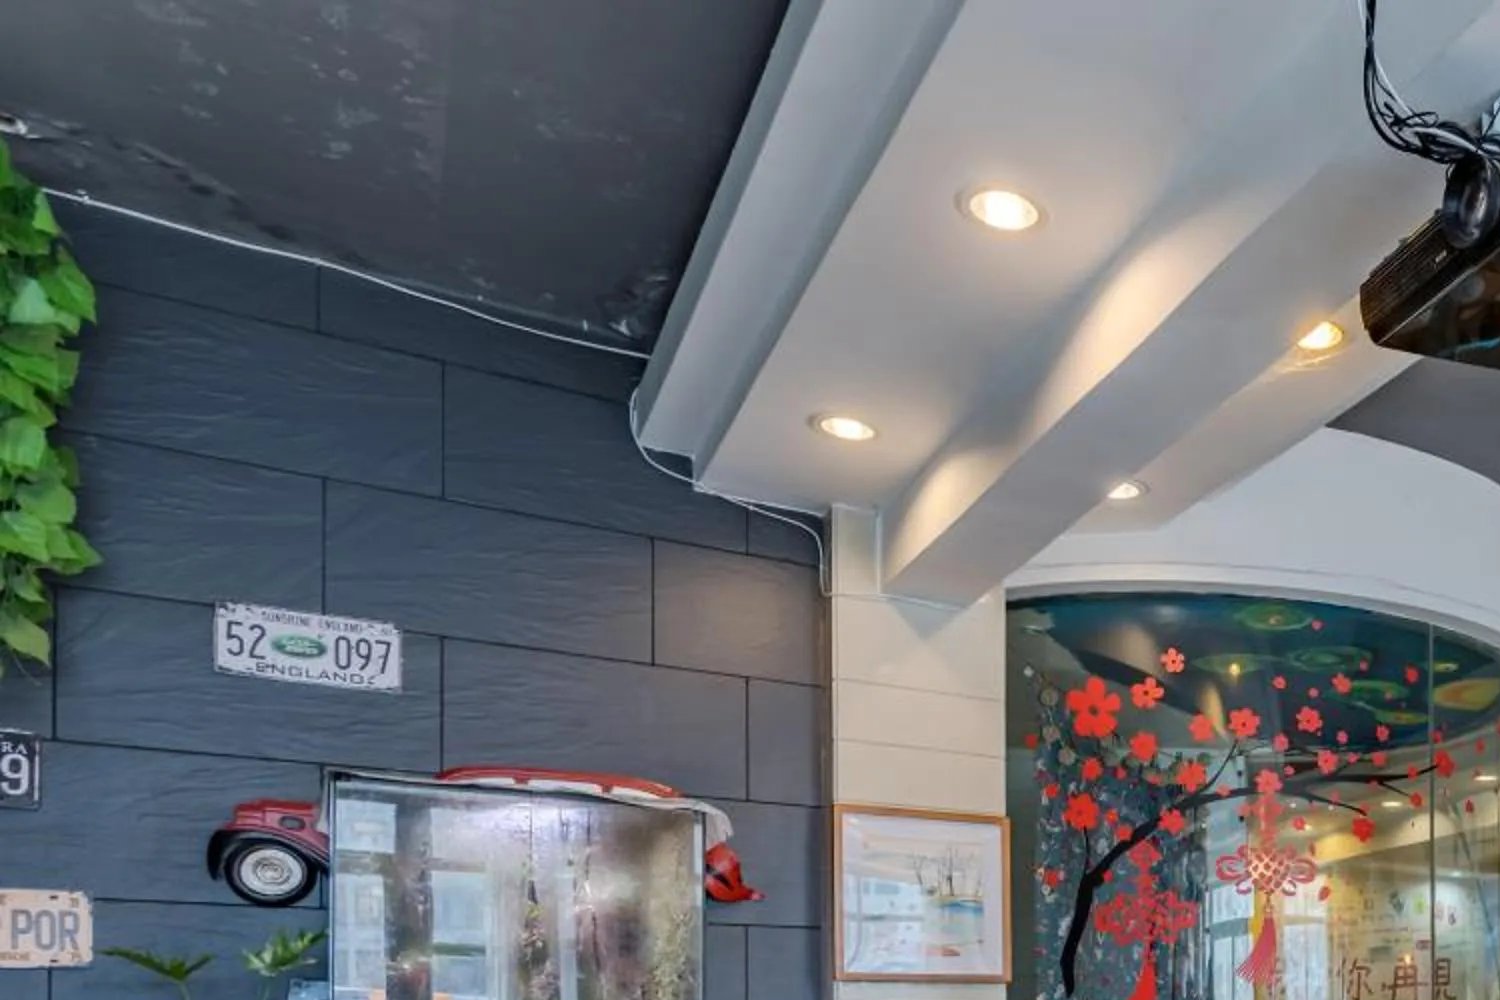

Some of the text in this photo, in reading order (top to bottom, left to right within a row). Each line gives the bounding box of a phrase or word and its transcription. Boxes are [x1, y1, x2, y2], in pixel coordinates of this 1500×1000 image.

[226, 619, 267, 661] 52
[334, 635, 392, 675] 097
[255, 661, 364, 686] ENGLAND
[11, 909, 81, 953] POR
